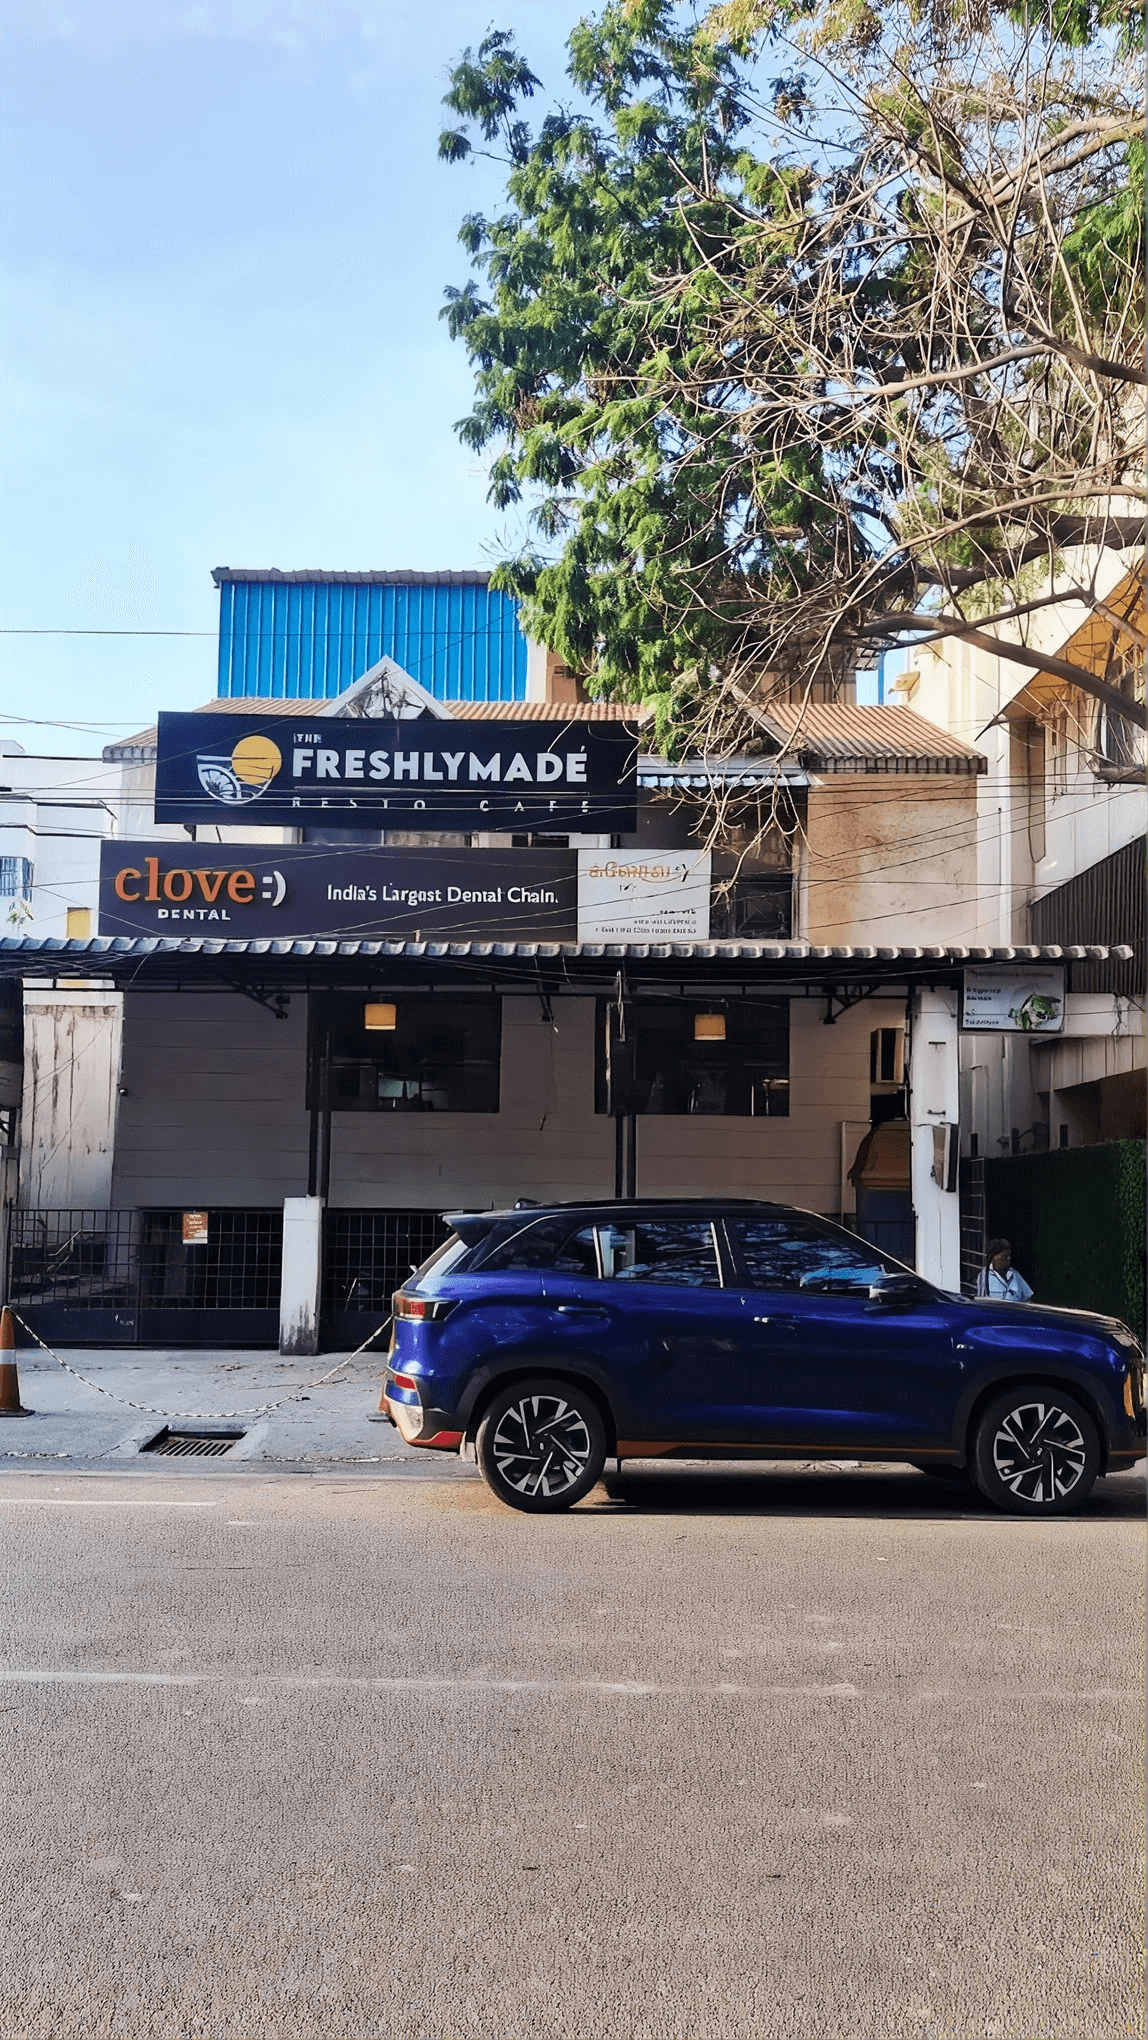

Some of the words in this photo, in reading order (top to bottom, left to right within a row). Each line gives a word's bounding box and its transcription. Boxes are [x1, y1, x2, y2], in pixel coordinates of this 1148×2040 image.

[327, 884, 377, 901] India's
[382, 882, 442, 906] Largest
[447, 886, 502, 903] Dental
[157, 908, 231, 921] DENTAL
